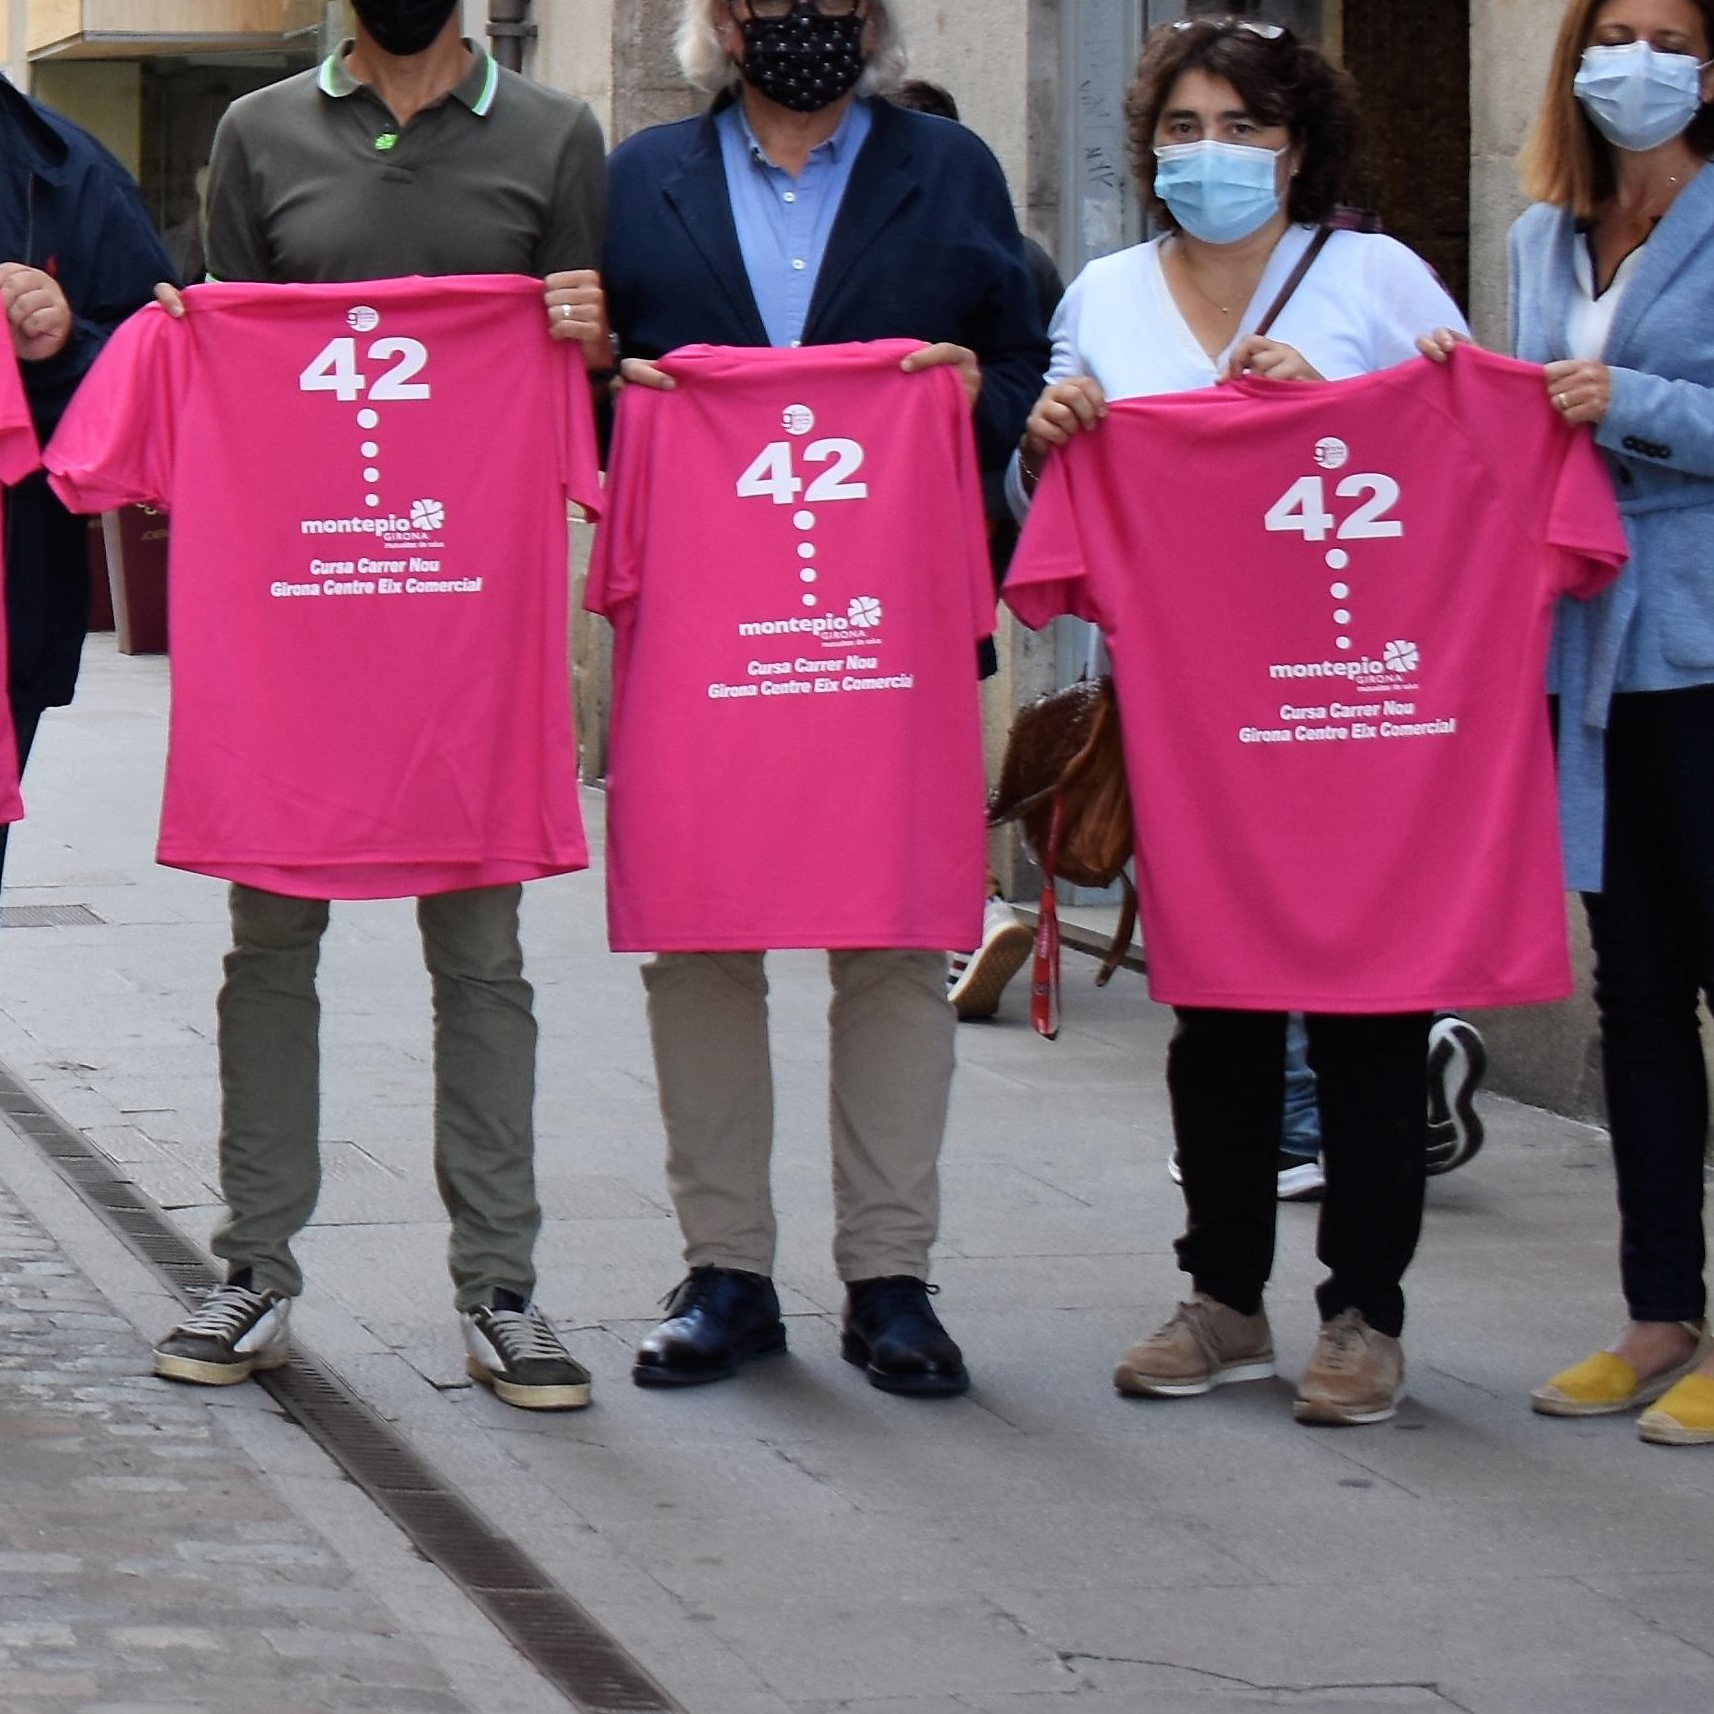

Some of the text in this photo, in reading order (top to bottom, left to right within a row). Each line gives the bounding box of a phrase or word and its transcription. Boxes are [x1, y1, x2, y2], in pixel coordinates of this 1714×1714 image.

[299, 336, 431, 402] 42
[735, 437, 868, 505] 42
[1264, 473, 1404, 541] 42
[301, 513, 411, 537] montepio
[383, 532, 429, 541] GIRONA
[310, 557, 441, 575] Cursa Carrer Nou
[270, 576, 483, 597] Girona Centre Eix Comercial
[738, 612, 849, 636] montepio
[747, 654, 878, 676] Cursa Carrer Nou
[1269, 656, 1384, 680] montepio
[707, 683, 758, 699] Girona
[760, 680, 811, 696] Centre
[813, 678, 840, 694] Eix
[1279, 700, 1415, 720] Cursa Carrer Nou
[1239, 717, 1457, 744] Girona Centre Eix Comercial
